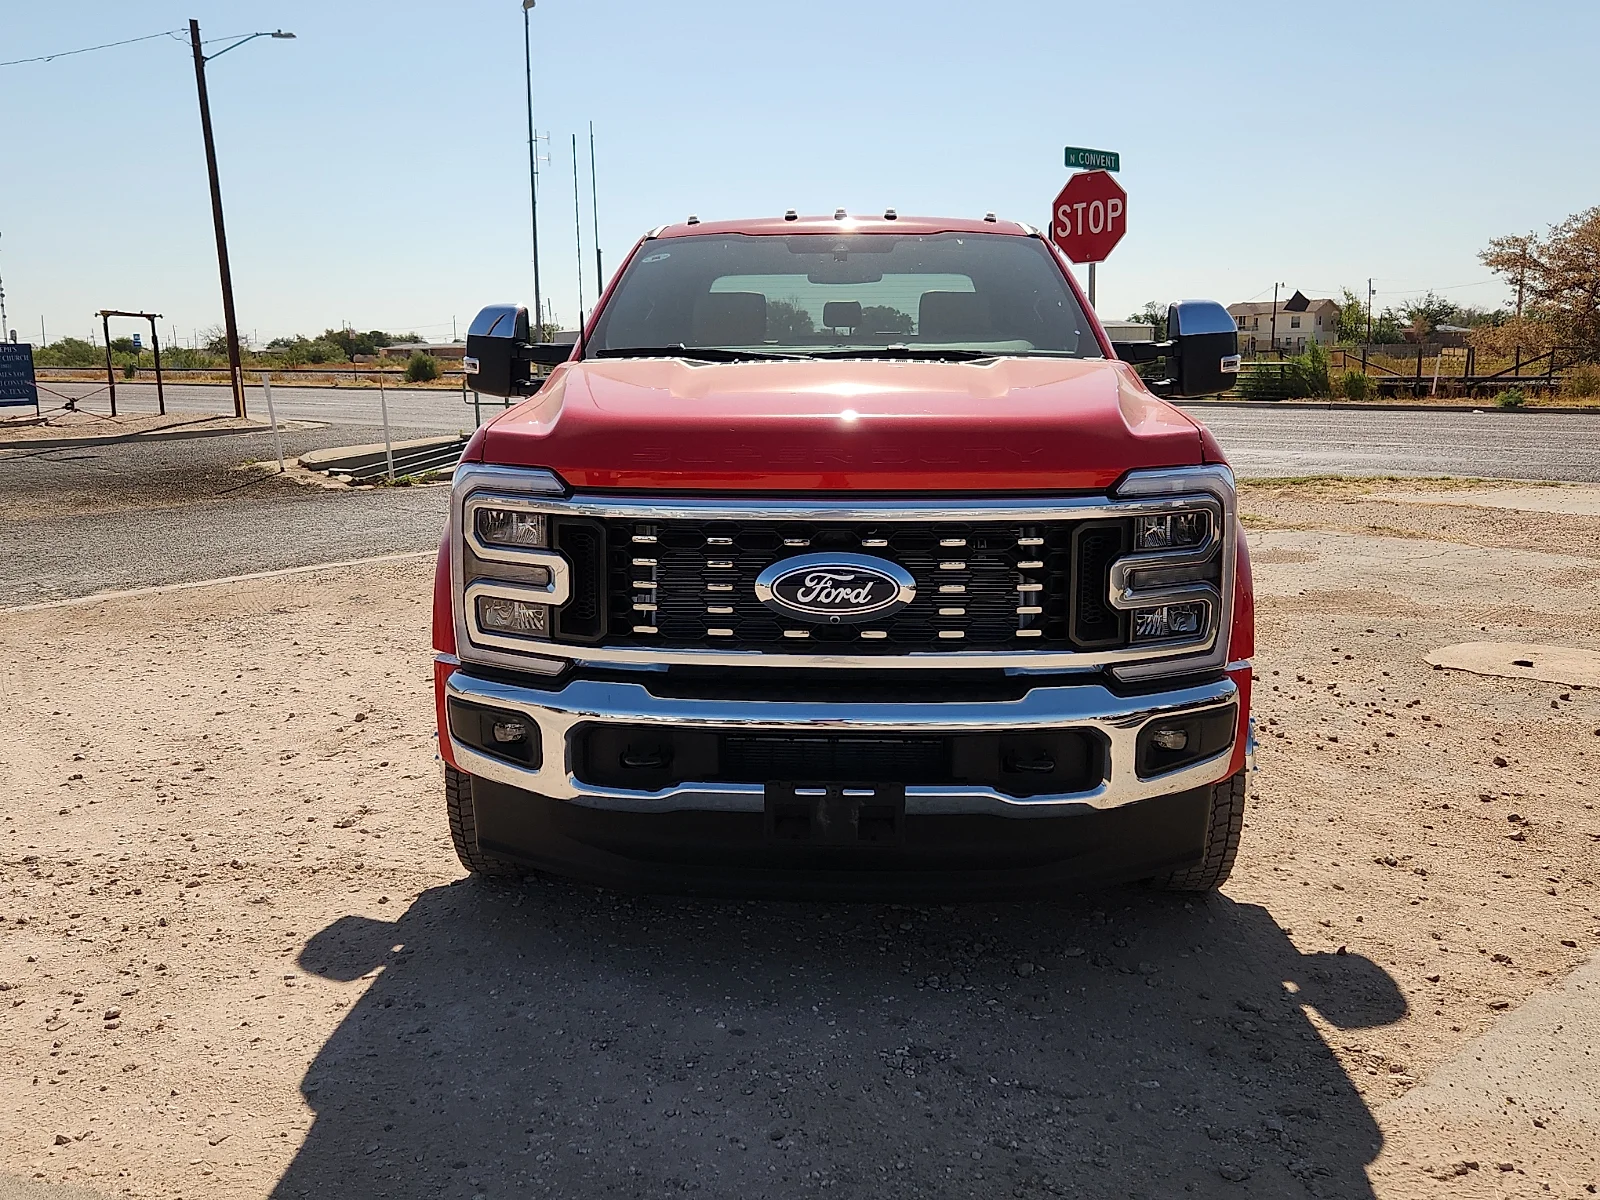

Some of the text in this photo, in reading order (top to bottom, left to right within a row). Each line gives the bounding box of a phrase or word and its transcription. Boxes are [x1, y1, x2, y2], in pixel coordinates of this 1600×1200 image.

[1070, 152, 1116, 168] N CONVENT
[1056, 198, 1123, 238] STOP
[2, 354, 30, 362] CHURCH
[797, 572, 874, 604] Ford
